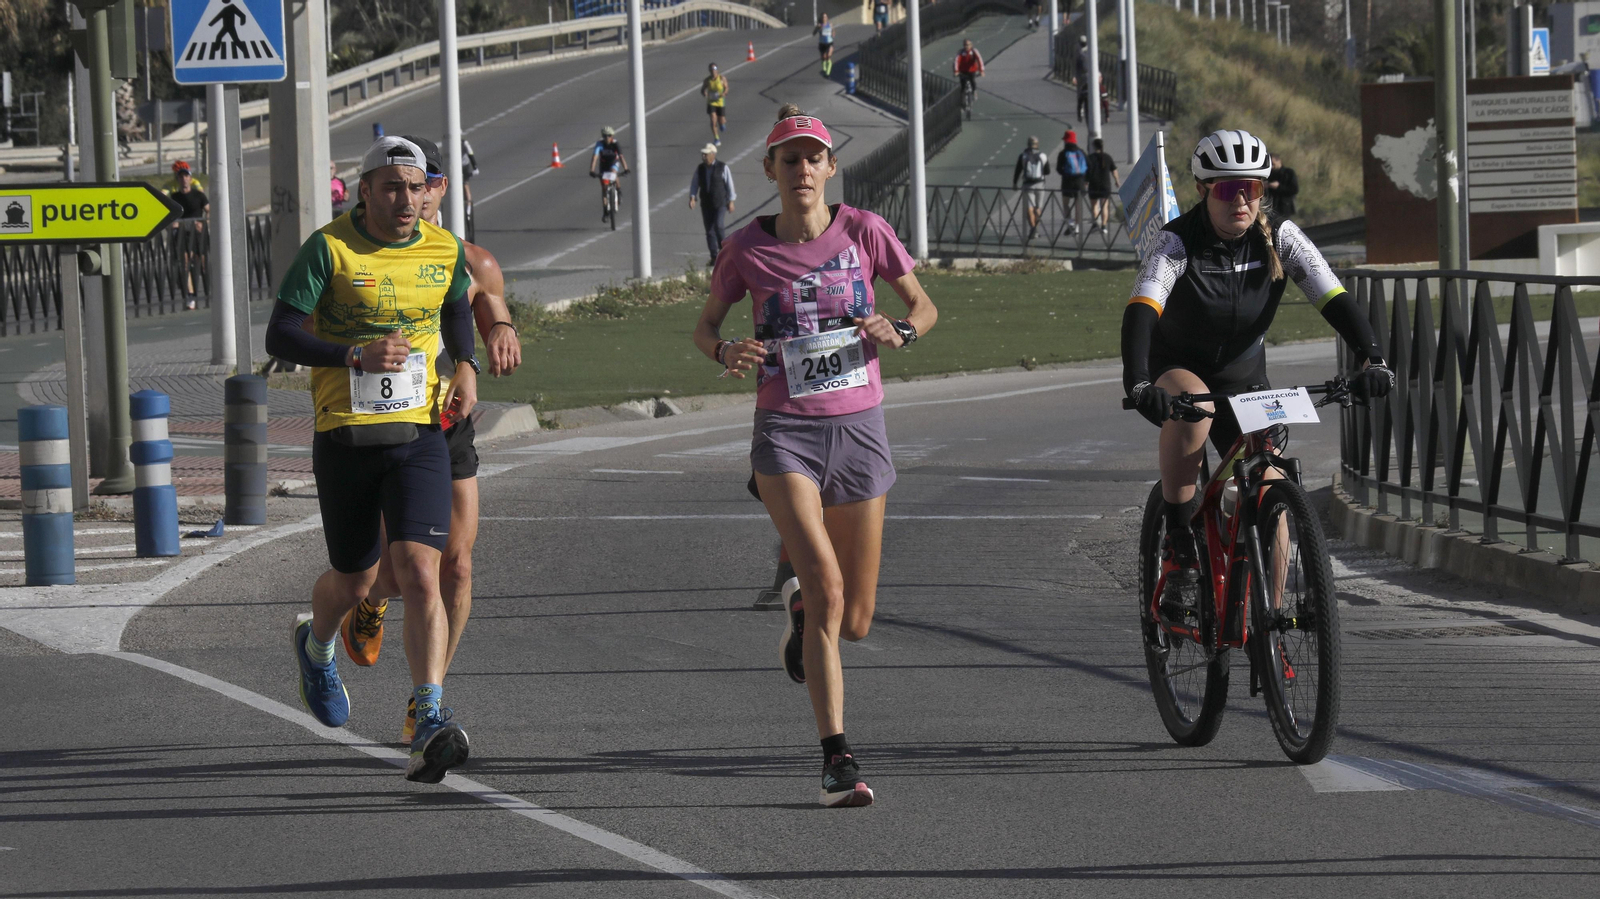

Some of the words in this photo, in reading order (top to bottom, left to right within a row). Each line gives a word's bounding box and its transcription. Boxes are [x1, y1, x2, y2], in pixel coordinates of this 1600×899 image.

[1471, 98, 1508, 106] PARQUES
[1510, 96, 1556, 105] NATURALES
[1487, 107, 1530, 116] PROVINCIA
[1532, 106, 1543, 114] DE
[1545, 104, 1570, 113] CÁDIZ
[41, 199, 139, 228] puerto
[1304, 253, 1322, 278] Bikes
[826, 285, 846, 296] NIKE
[827, 317, 842, 327] NIKE
[801, 353, 842, 381] 249
[380, 377, 393, 399] 8
[811, 379, 849, 392] EVOS
[1240, 392, 1300, 403] ORGANIZACIÓN
[373, 401, 410, 411] EVOS
